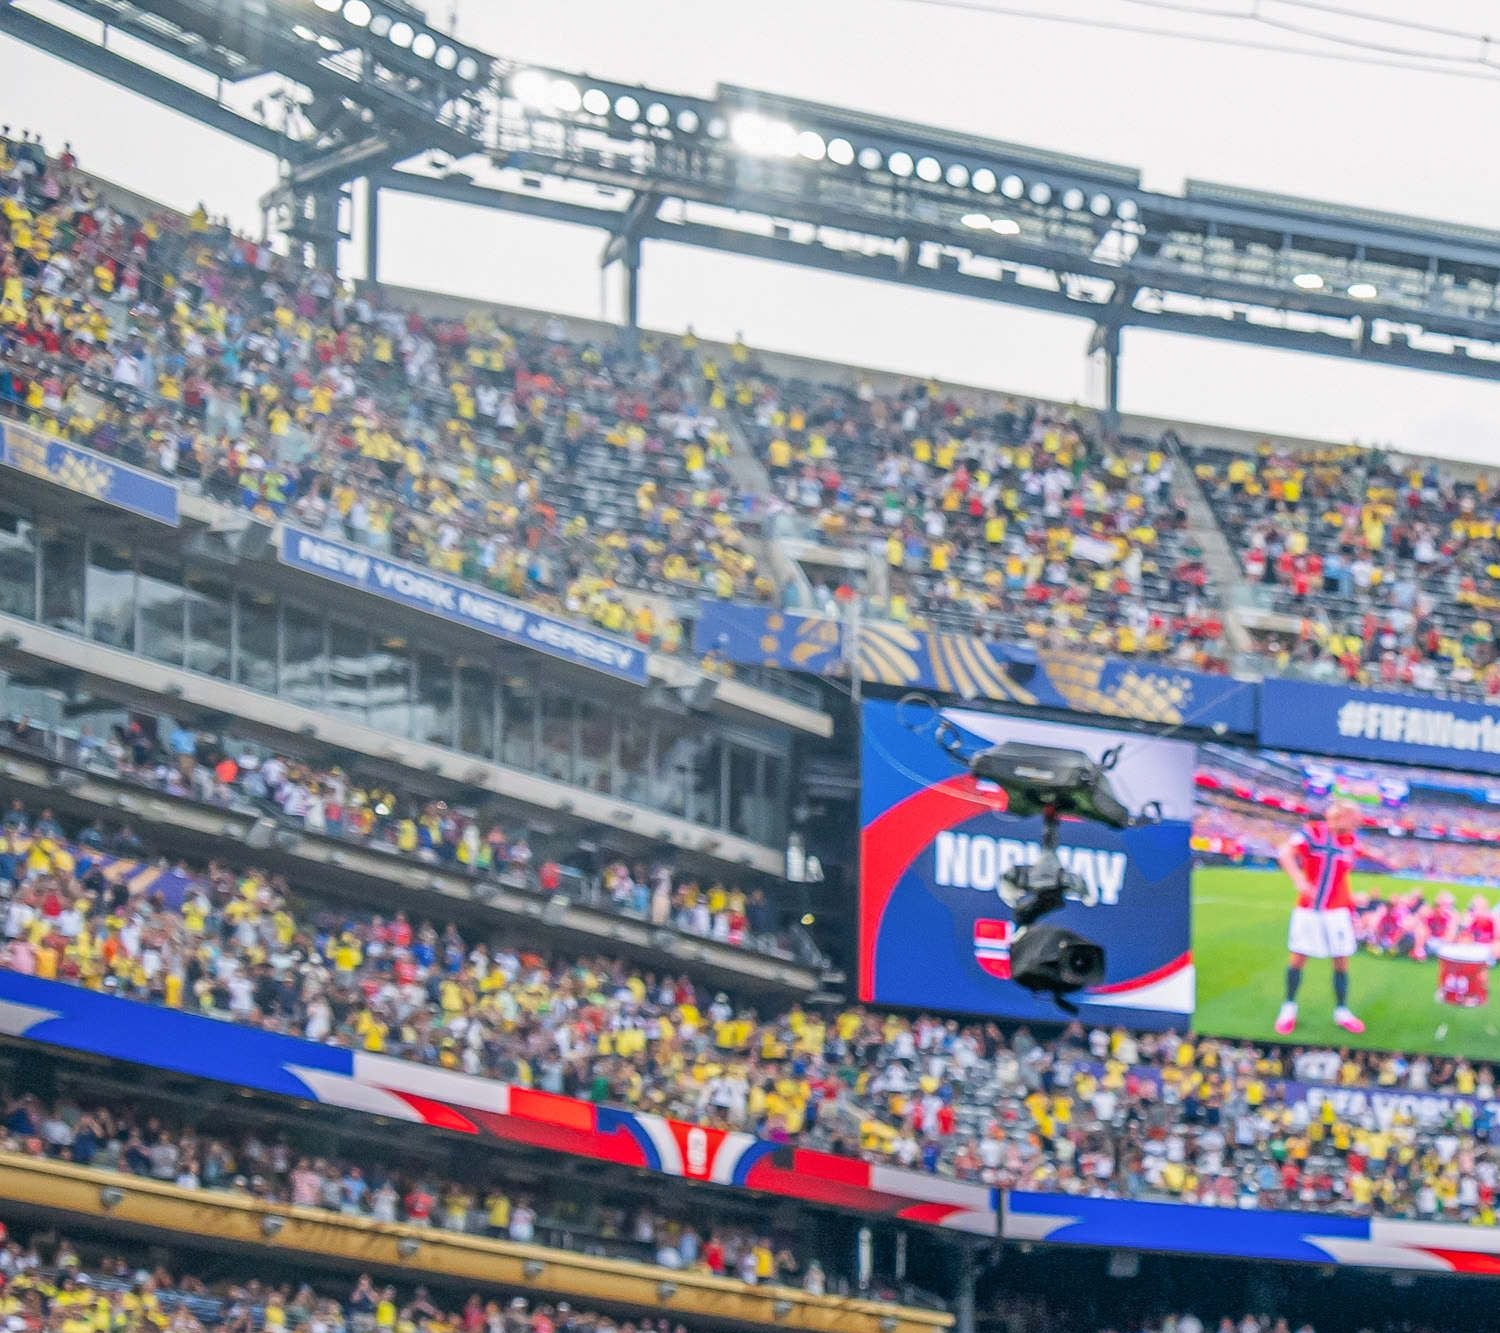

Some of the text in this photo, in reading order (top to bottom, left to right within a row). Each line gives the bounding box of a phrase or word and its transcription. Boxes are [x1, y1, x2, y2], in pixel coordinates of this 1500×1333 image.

[299, 536, 635, 669] NEW YORK NEW JERSEY
